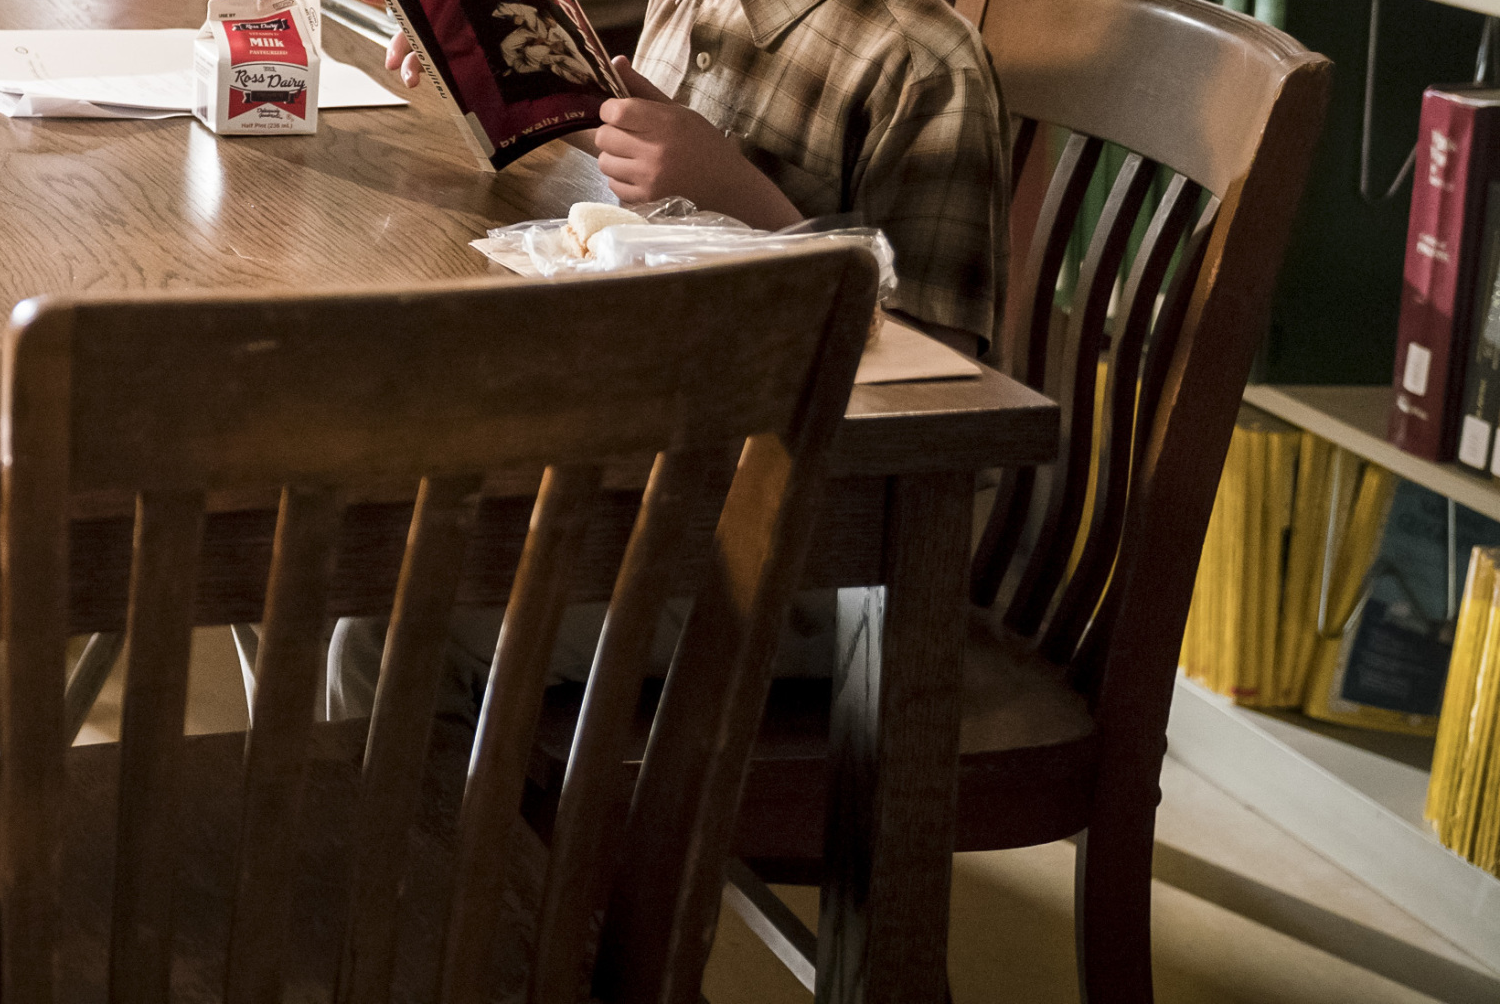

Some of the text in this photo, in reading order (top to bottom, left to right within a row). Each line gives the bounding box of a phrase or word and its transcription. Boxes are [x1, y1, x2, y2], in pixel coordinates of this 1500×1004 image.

[249, 37, 285, 48] Milk
[235, 69, 306, 98] Ross Dairy
[500, 135, 516, 148] by
[521, 115, 560, 135] wally
